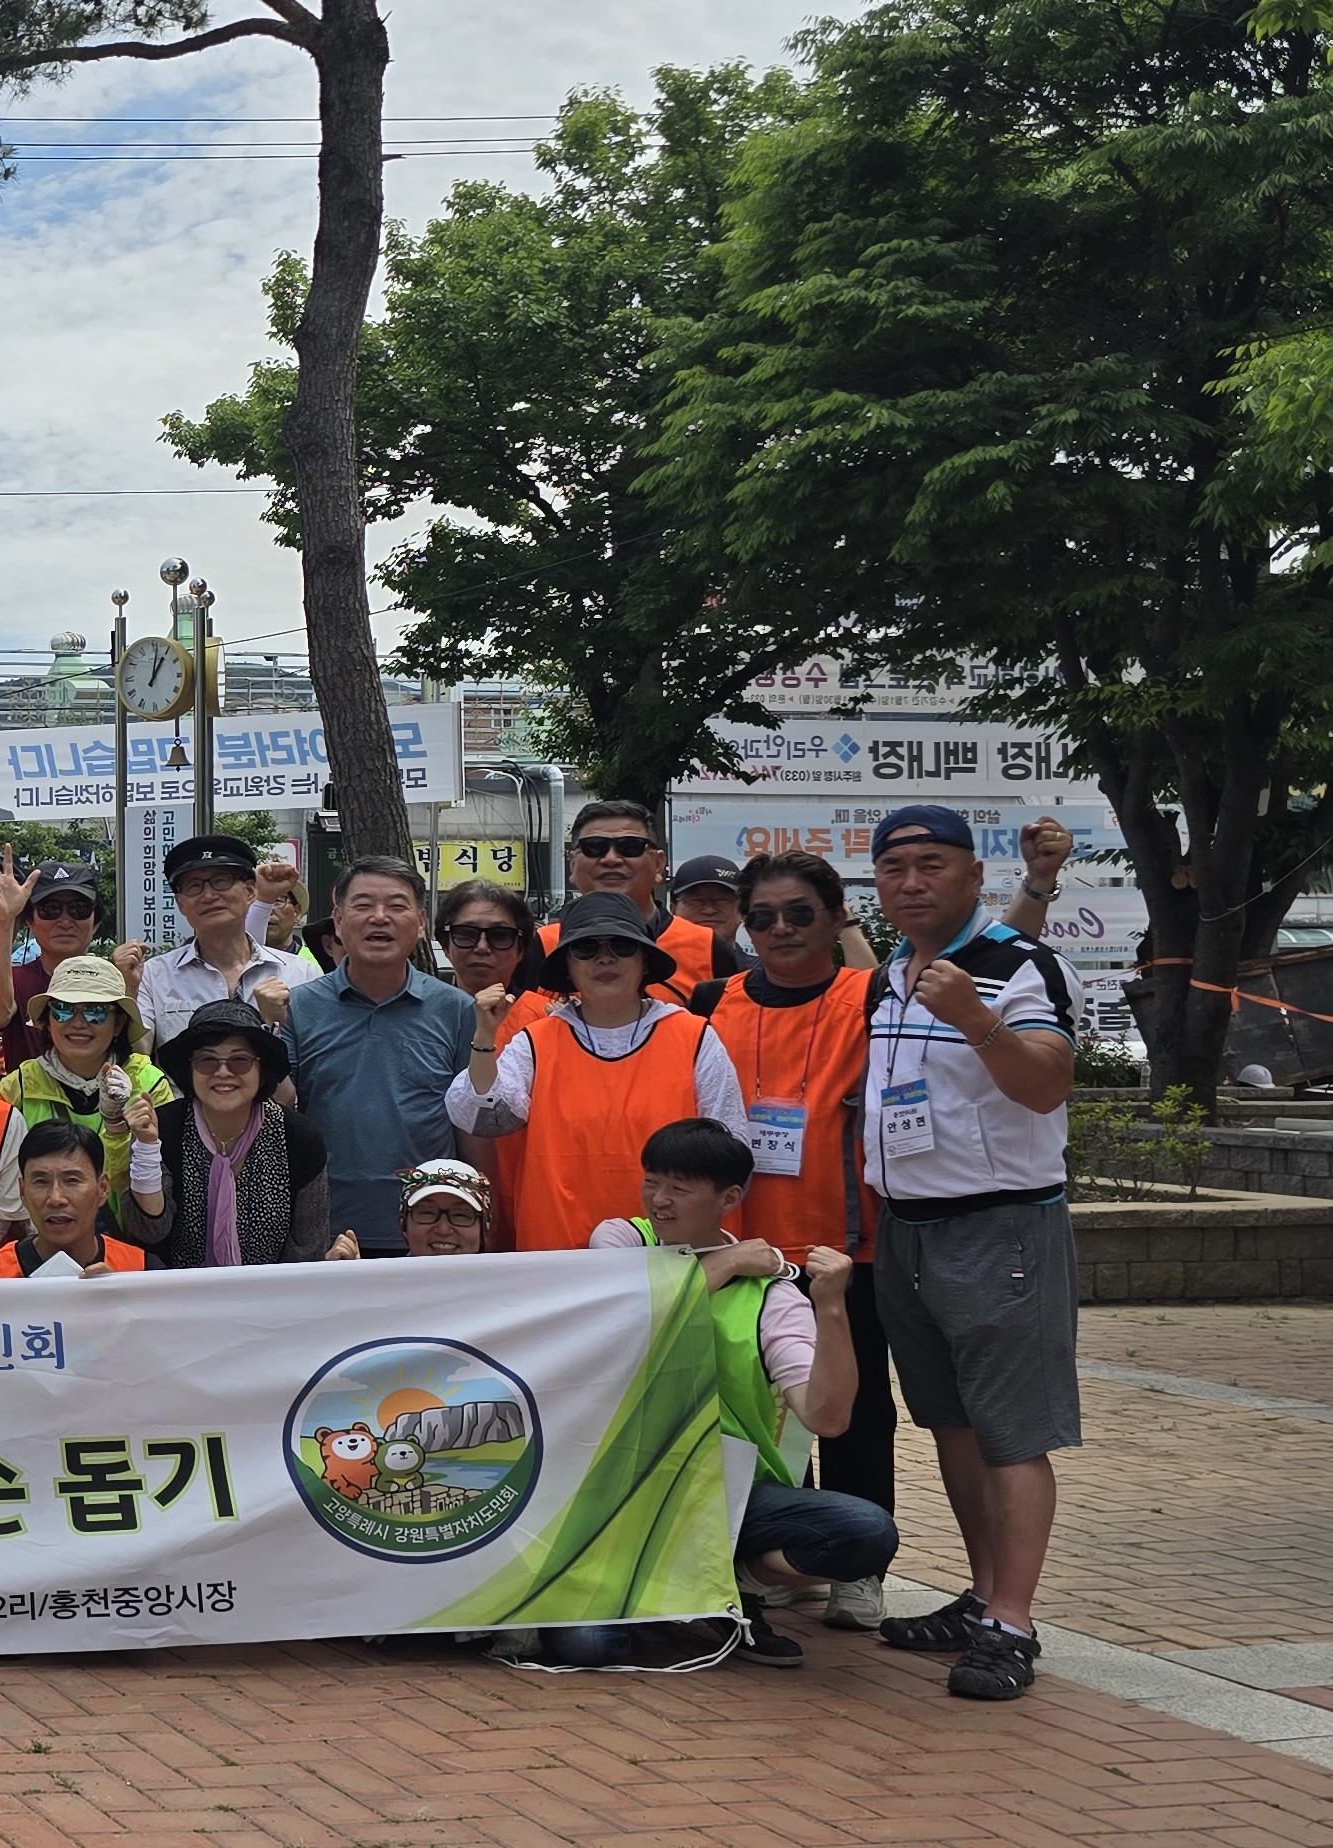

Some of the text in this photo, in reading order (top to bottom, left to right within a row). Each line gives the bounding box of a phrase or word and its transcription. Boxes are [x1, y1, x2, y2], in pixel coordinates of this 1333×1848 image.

[143, 896, 157, 944] 보이지
[52, 1429, 242, 1536] 돕기
[321, 1485, 520, 1545] 고양특례시 강원특별자치도민회
